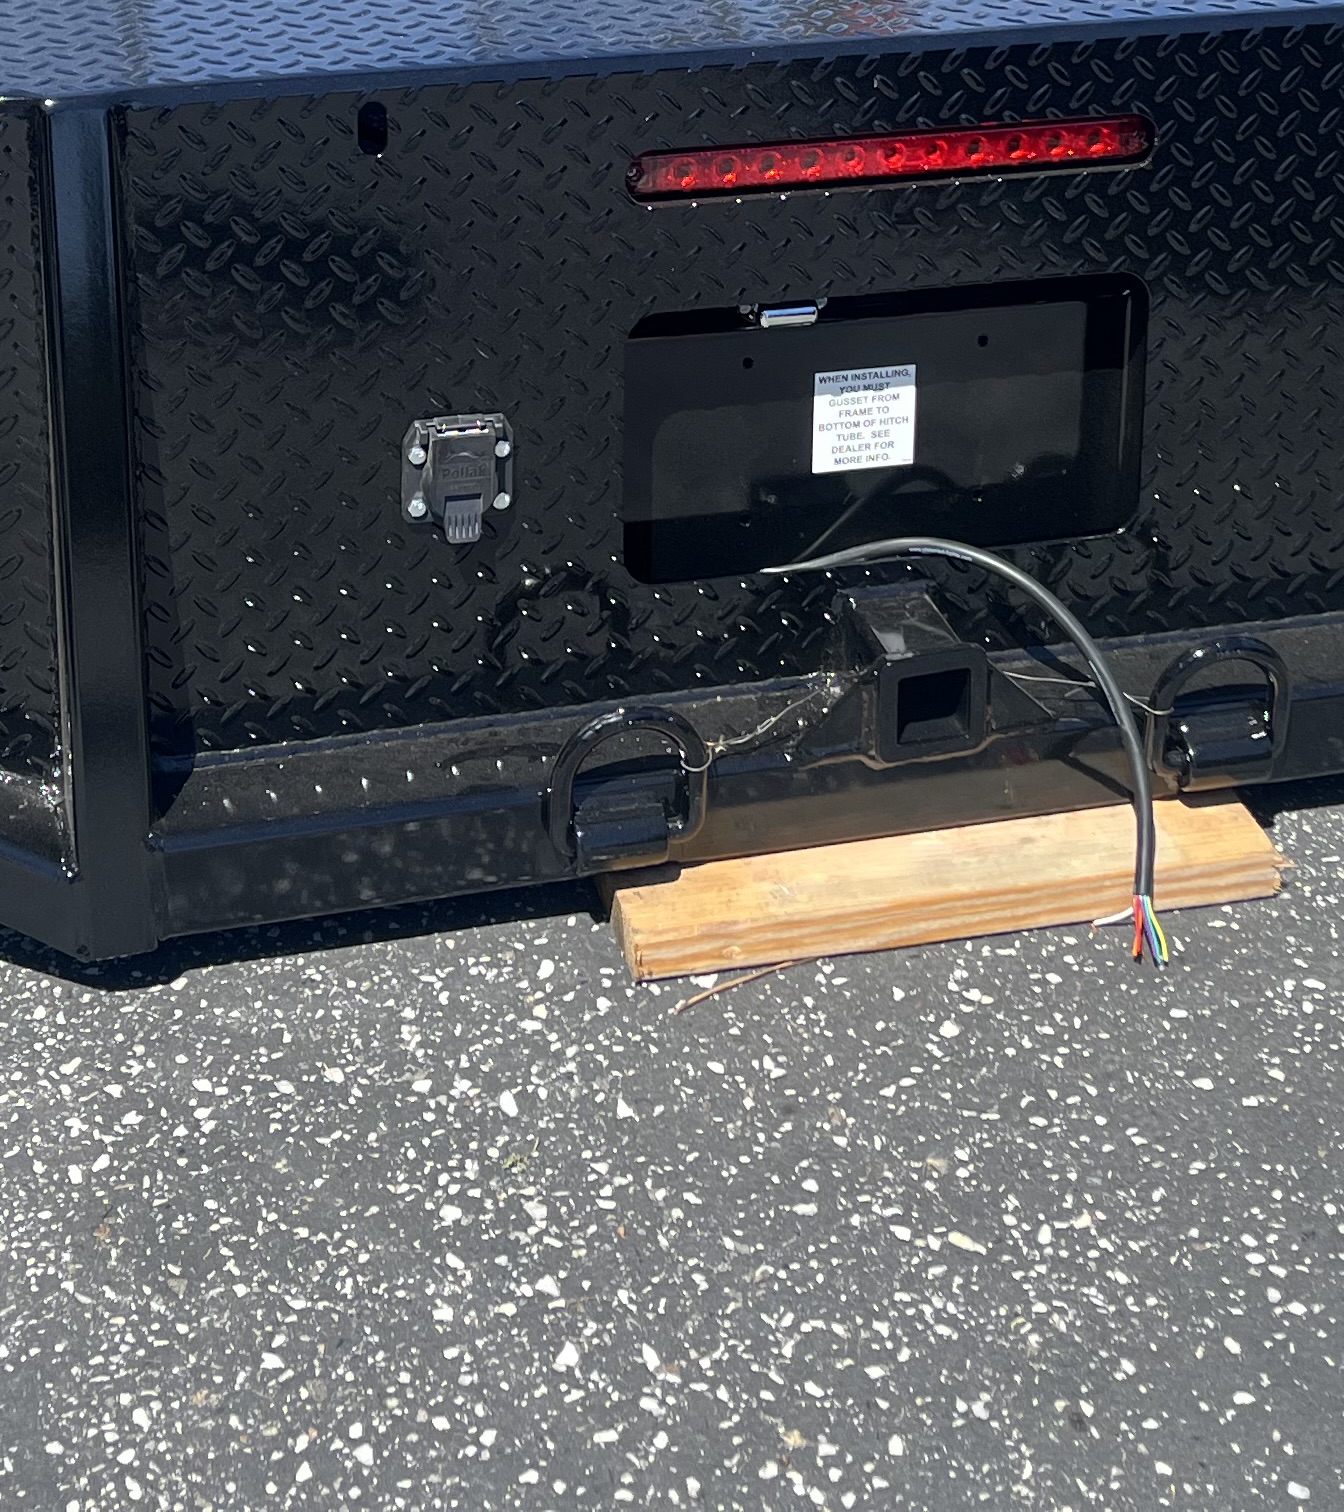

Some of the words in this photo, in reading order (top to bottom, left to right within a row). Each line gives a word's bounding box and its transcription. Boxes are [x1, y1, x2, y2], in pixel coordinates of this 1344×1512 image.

[818, 374, 848, 384] WHEN
[839, 385, 861, 394] YOU
[862, 382, 891, 392] MUST
[829, 396, 868, 407] GUSSET
[871, 393, 900, 403] FROM
[839, 407, 873, 418] FRAME
[876, 406, 890, 414] TO
[818, 420, 861, 432] BOTTOM
[863, 419, 877, 428] OF
[879, 416, 909, 426] HITCH
[870, 429, 891, 439] SEE
[831, 443, 871, 454] DEALER
[874, 440, 895, 450] FOR
[834, 455, 863, 465] MORE
